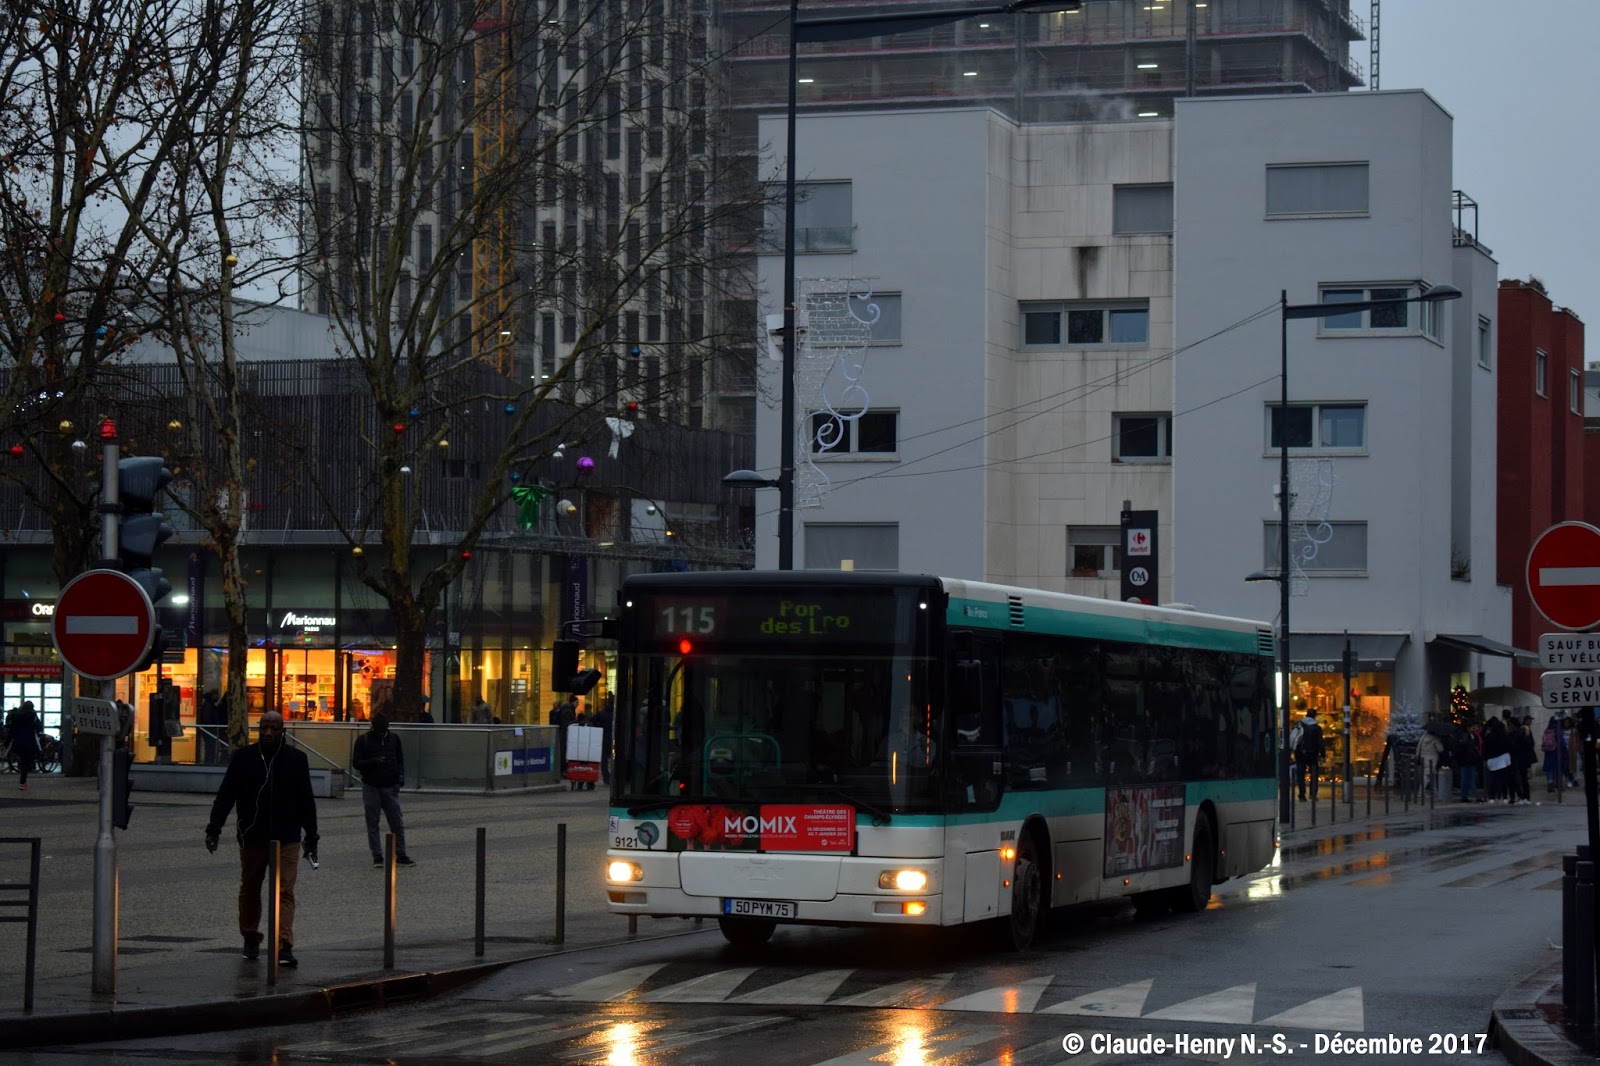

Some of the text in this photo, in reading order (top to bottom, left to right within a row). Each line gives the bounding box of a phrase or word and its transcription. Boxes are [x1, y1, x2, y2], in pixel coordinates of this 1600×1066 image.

[571, 583, 581, 633] Mrionnaud
[661, 606, 715, 634] 115
[760, 617, 803, 634] des
[1548, 640, 1582, 650] SAUF
[1549, 654, 1564, 663] ET
[1563, 676, 1600, 689] SAU
[1550, 690, 1599, 703] SERVI
[78, 704, 110, 717] SAUF BUS
[80, 717, 112, 730] ET VÉLOS
[724, 815, 798, 834] MOMIX
[615, 837, 638, 848] 9121
[735, 901, 789, 916] 50 PYM 75
